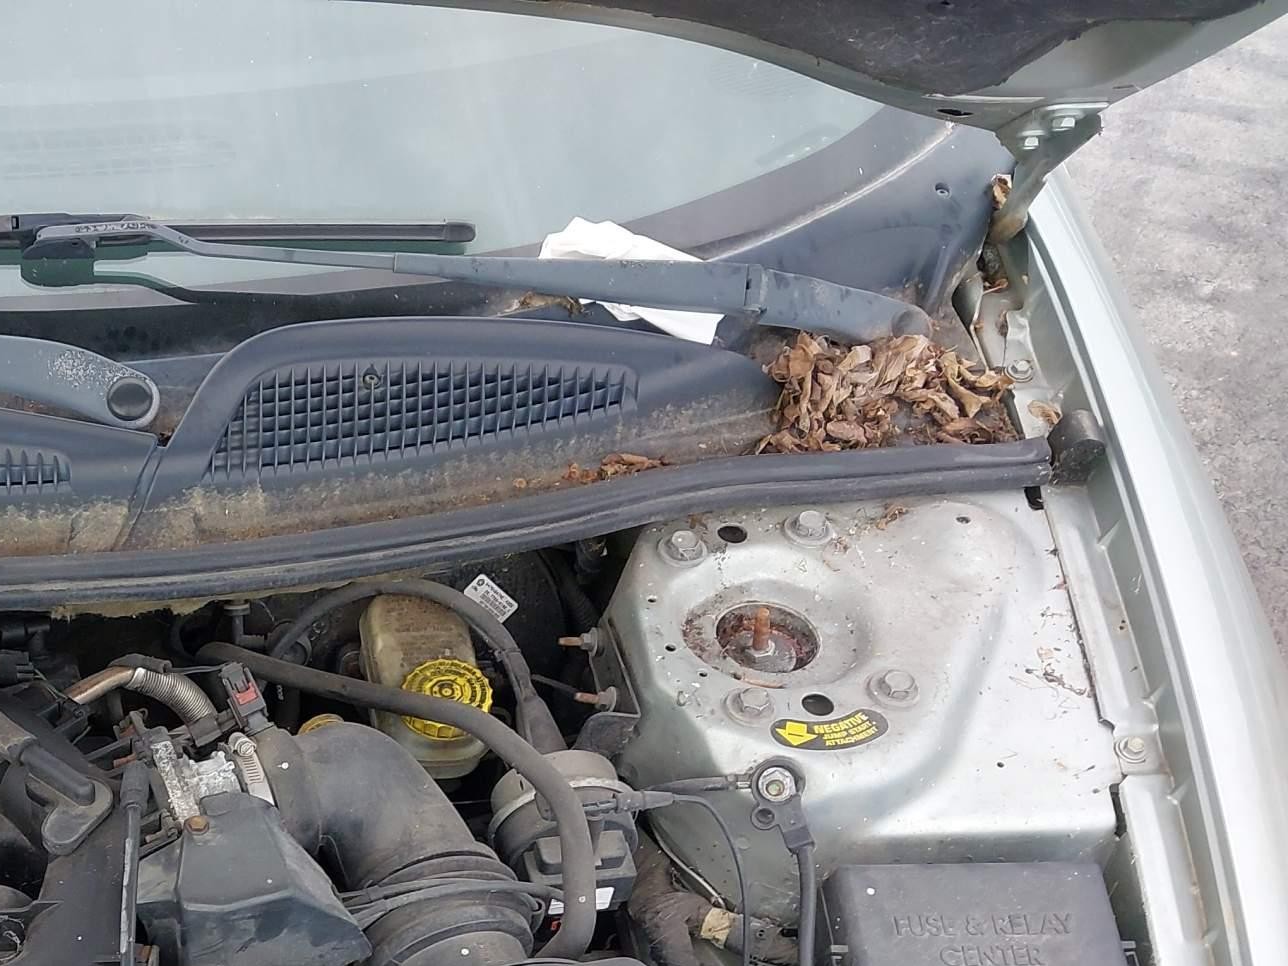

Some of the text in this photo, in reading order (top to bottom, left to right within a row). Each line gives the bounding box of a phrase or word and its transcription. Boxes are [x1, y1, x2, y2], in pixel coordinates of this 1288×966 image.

[813, 712, 869, 734] NEGATIVE
[822, 721, 872, 740] JUMP START
[825, 727, 879, 746] ATTACHMENT
[893, 912, 1072, 937] FUSE & RELAY
